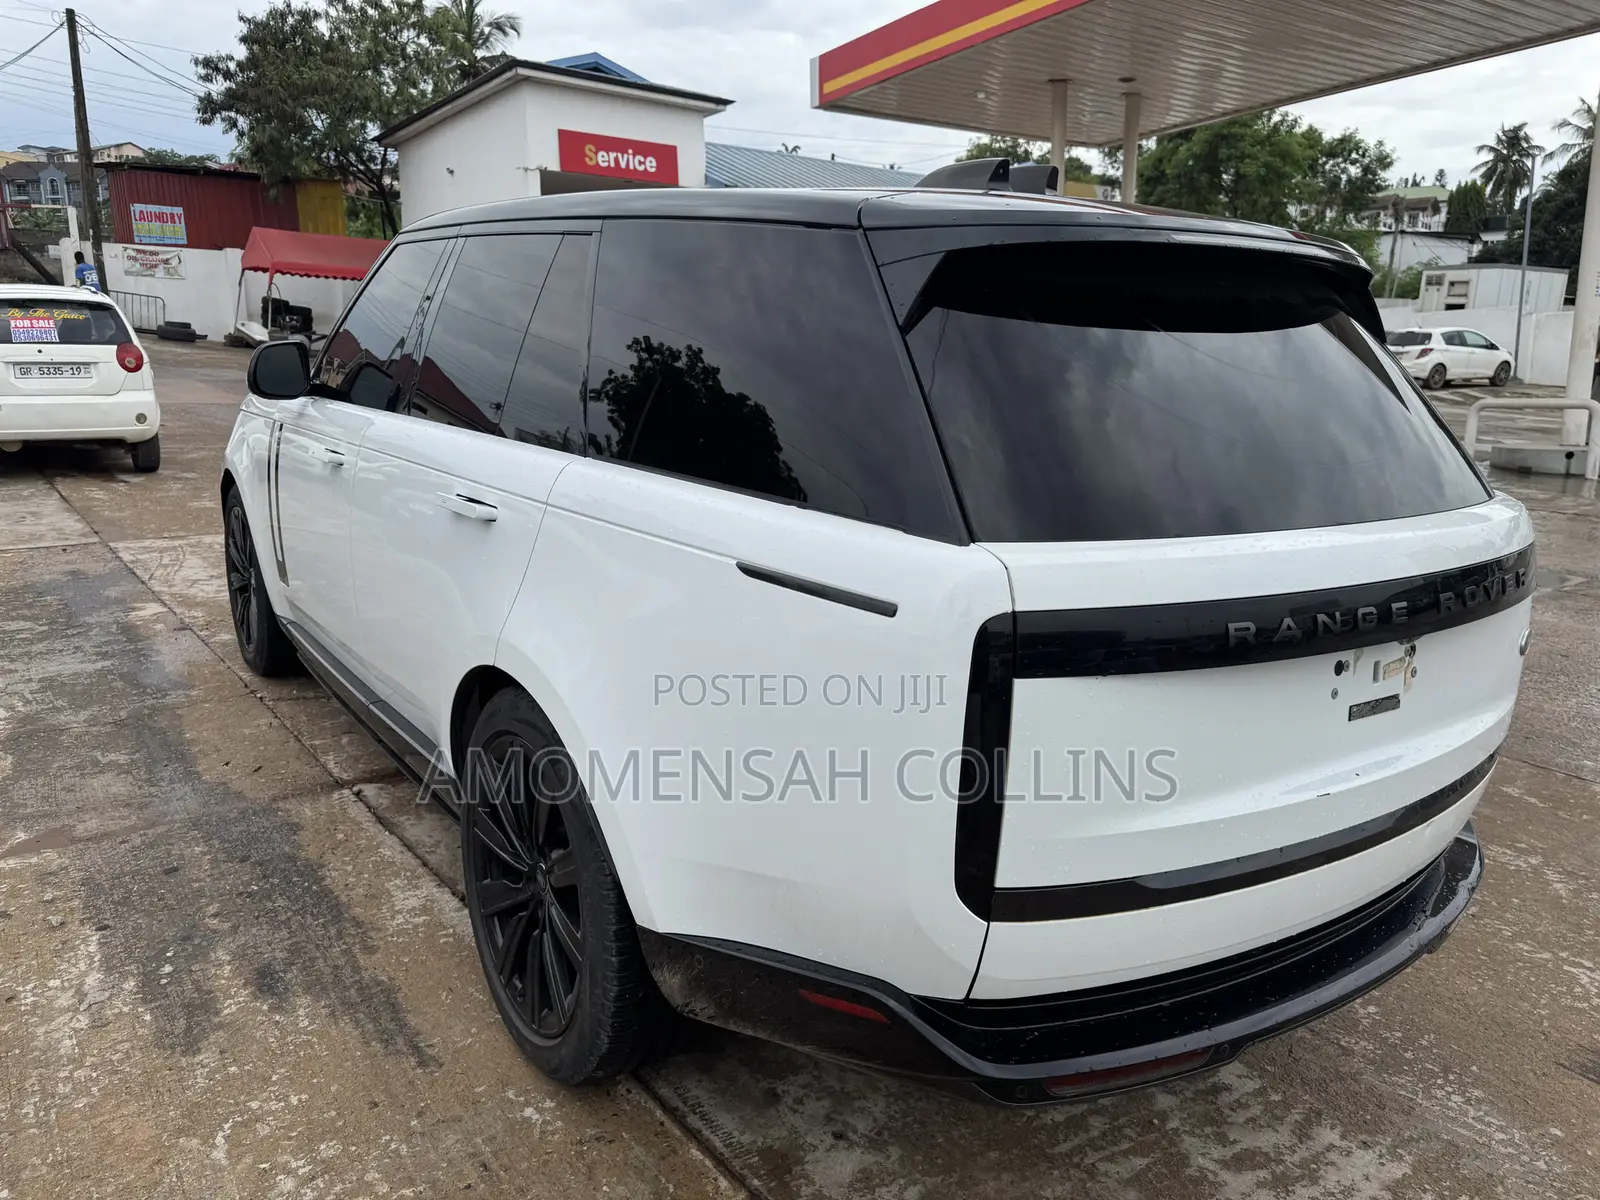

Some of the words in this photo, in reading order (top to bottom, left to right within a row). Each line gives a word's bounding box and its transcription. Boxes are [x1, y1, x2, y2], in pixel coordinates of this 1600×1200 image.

[584, 144, 657, 173] Service
[132, 209, 183, 225] LAUNDRY
[3, 308, 24, 318] By
[27, 308, 51, 318] The
[53, 309, 87, 321] Grace
[11, 319, 32, 328] FOR
[32, 319, 56, 328] SALE
[19, 366, 33, 376] GR
[38, 366, 82, 376] 5335-19
[1226, 600, 1409, 649] RANGE
[1437, 567, 1527, 615] ROVER
